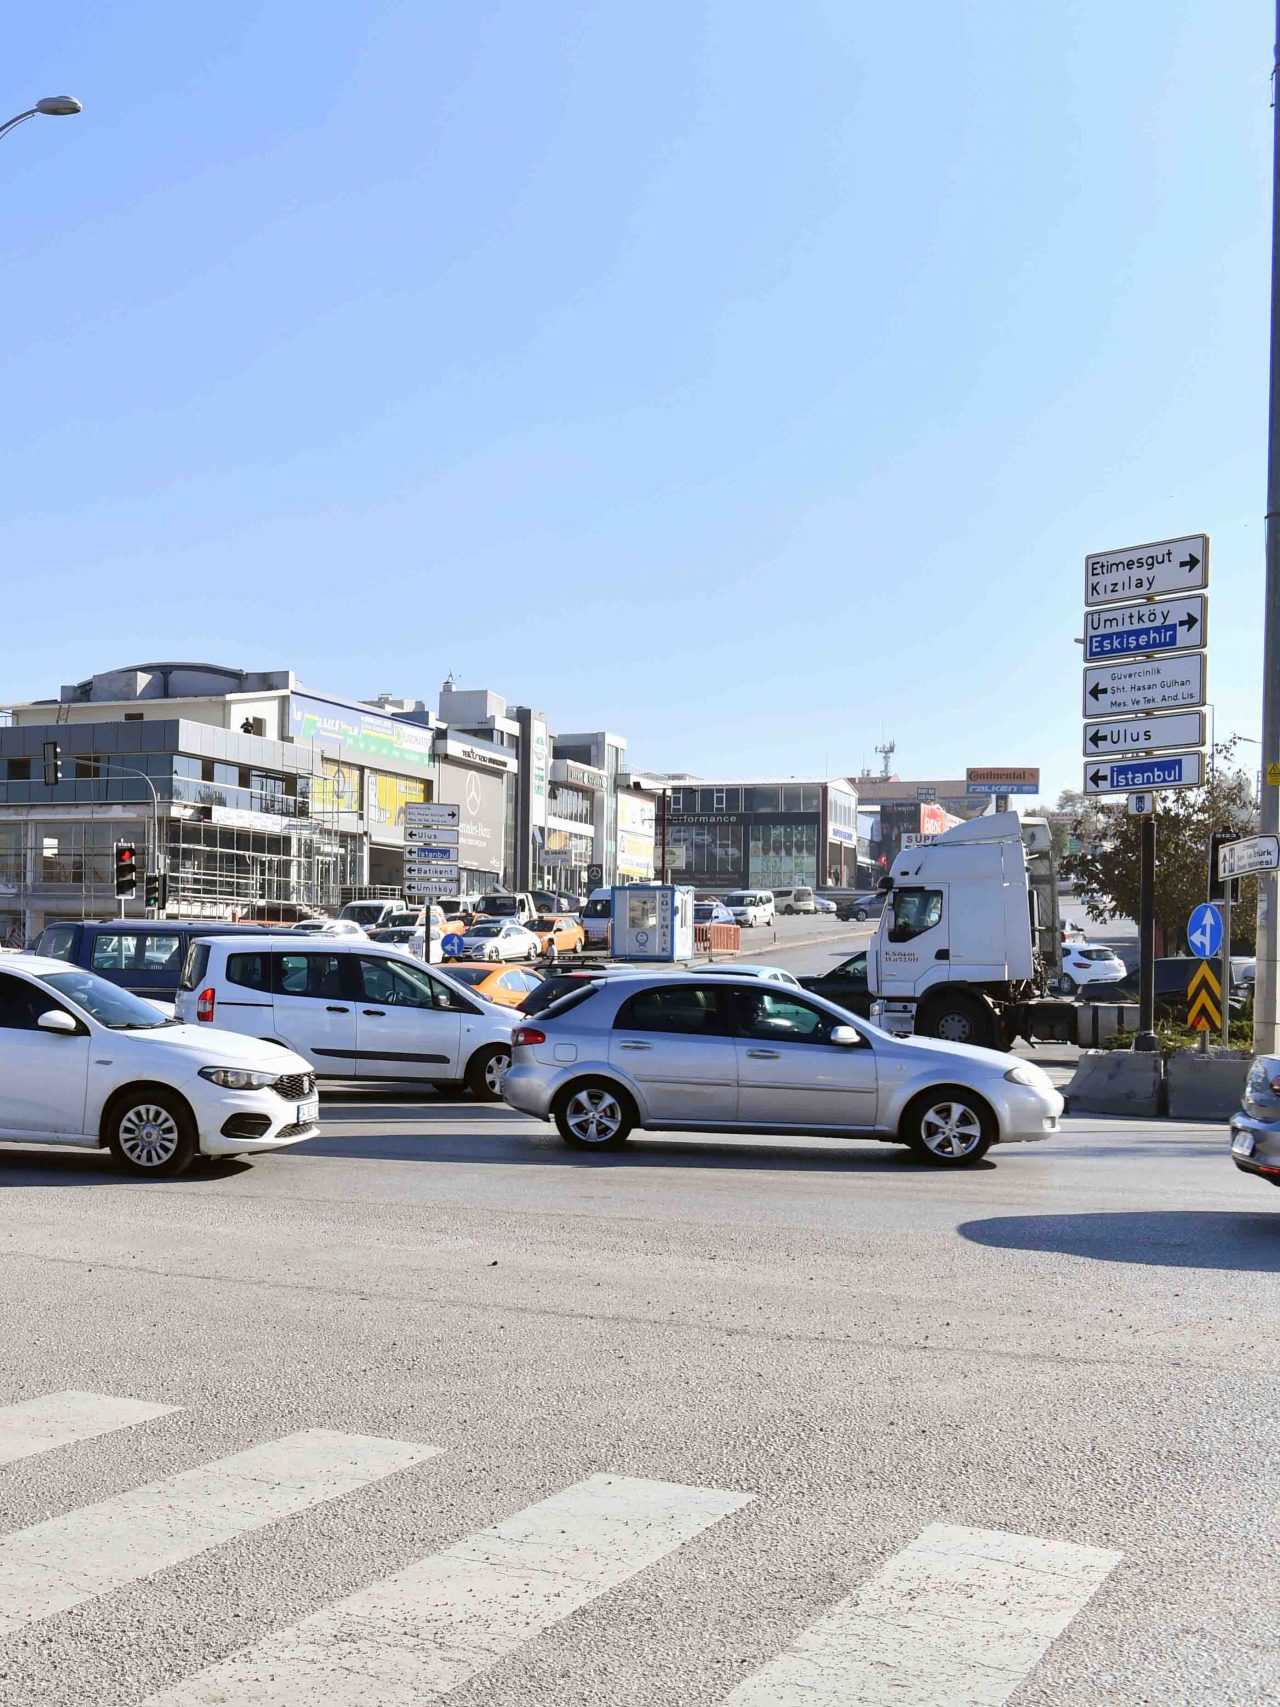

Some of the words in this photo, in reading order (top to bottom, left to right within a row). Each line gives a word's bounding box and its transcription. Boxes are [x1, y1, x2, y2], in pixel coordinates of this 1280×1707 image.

[1091, 549, 1173, 577] Etimesgut
[1091, 575, 1156, 597] Kızılay
[1090, 608, 1171, 631] Ümitköy
[1092, 628, 1174, 652] Eskişehir
[1110, 667, 1162, 681] Güvercinlik
[1130, 682, 1157, 693] Hasan
[1160, 679, 1191, 689] Gülhan
[1110, 700, 1129, 709] Mes.
[1131, 698, 1140, 706] Ve
[1110, 728, 1152, 745] Ulus
[968, 770, 1026, 781] Continental
[1113, 764, 1179, 787] İstanbul
[417, 832, 438, 840] Ulus
